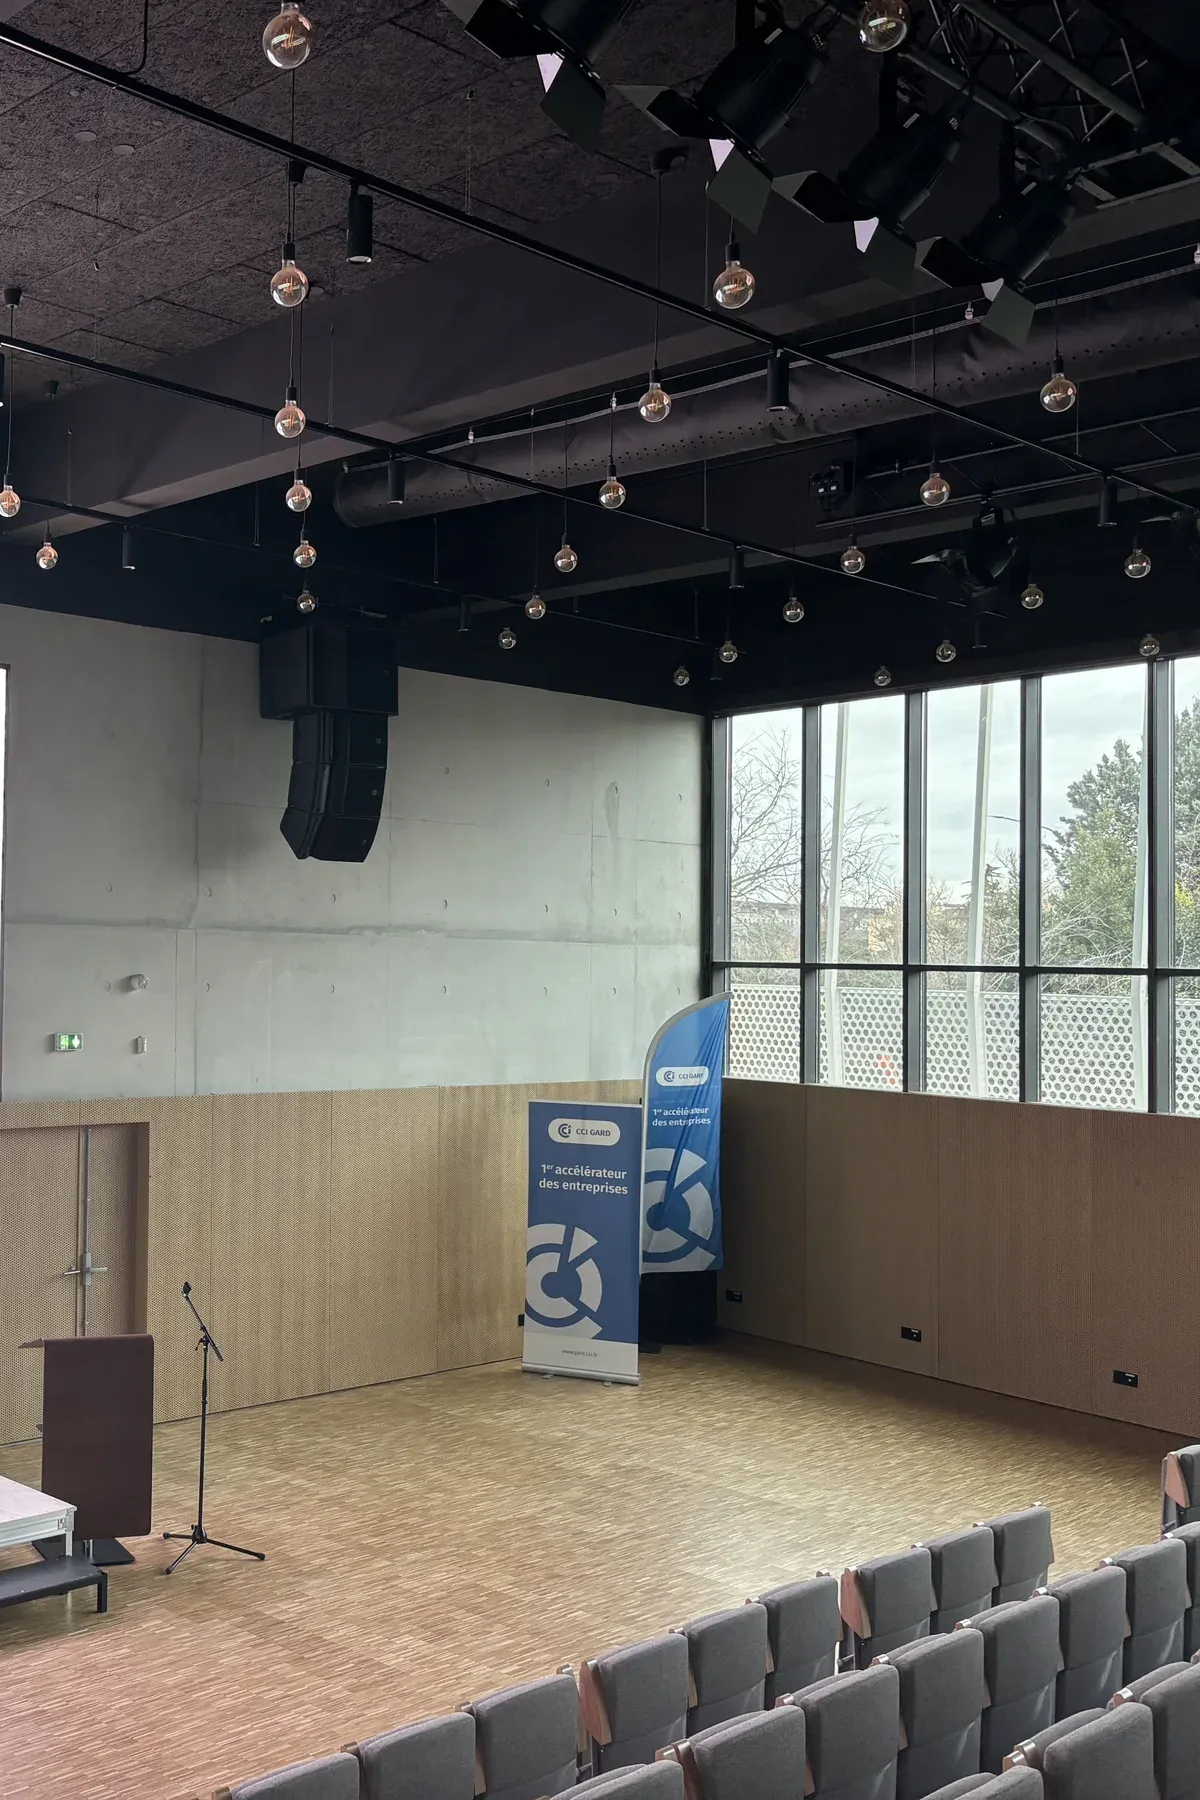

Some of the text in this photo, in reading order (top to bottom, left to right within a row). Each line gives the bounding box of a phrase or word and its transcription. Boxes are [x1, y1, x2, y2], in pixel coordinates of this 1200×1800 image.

[652, 1118, 667, 1126] des
[575, 1128, 611, 1137] CCI GARD
[541, 1164, 627, 1179] 1er accélérateur
[539, 1178, 628, 1195] des entreprises
